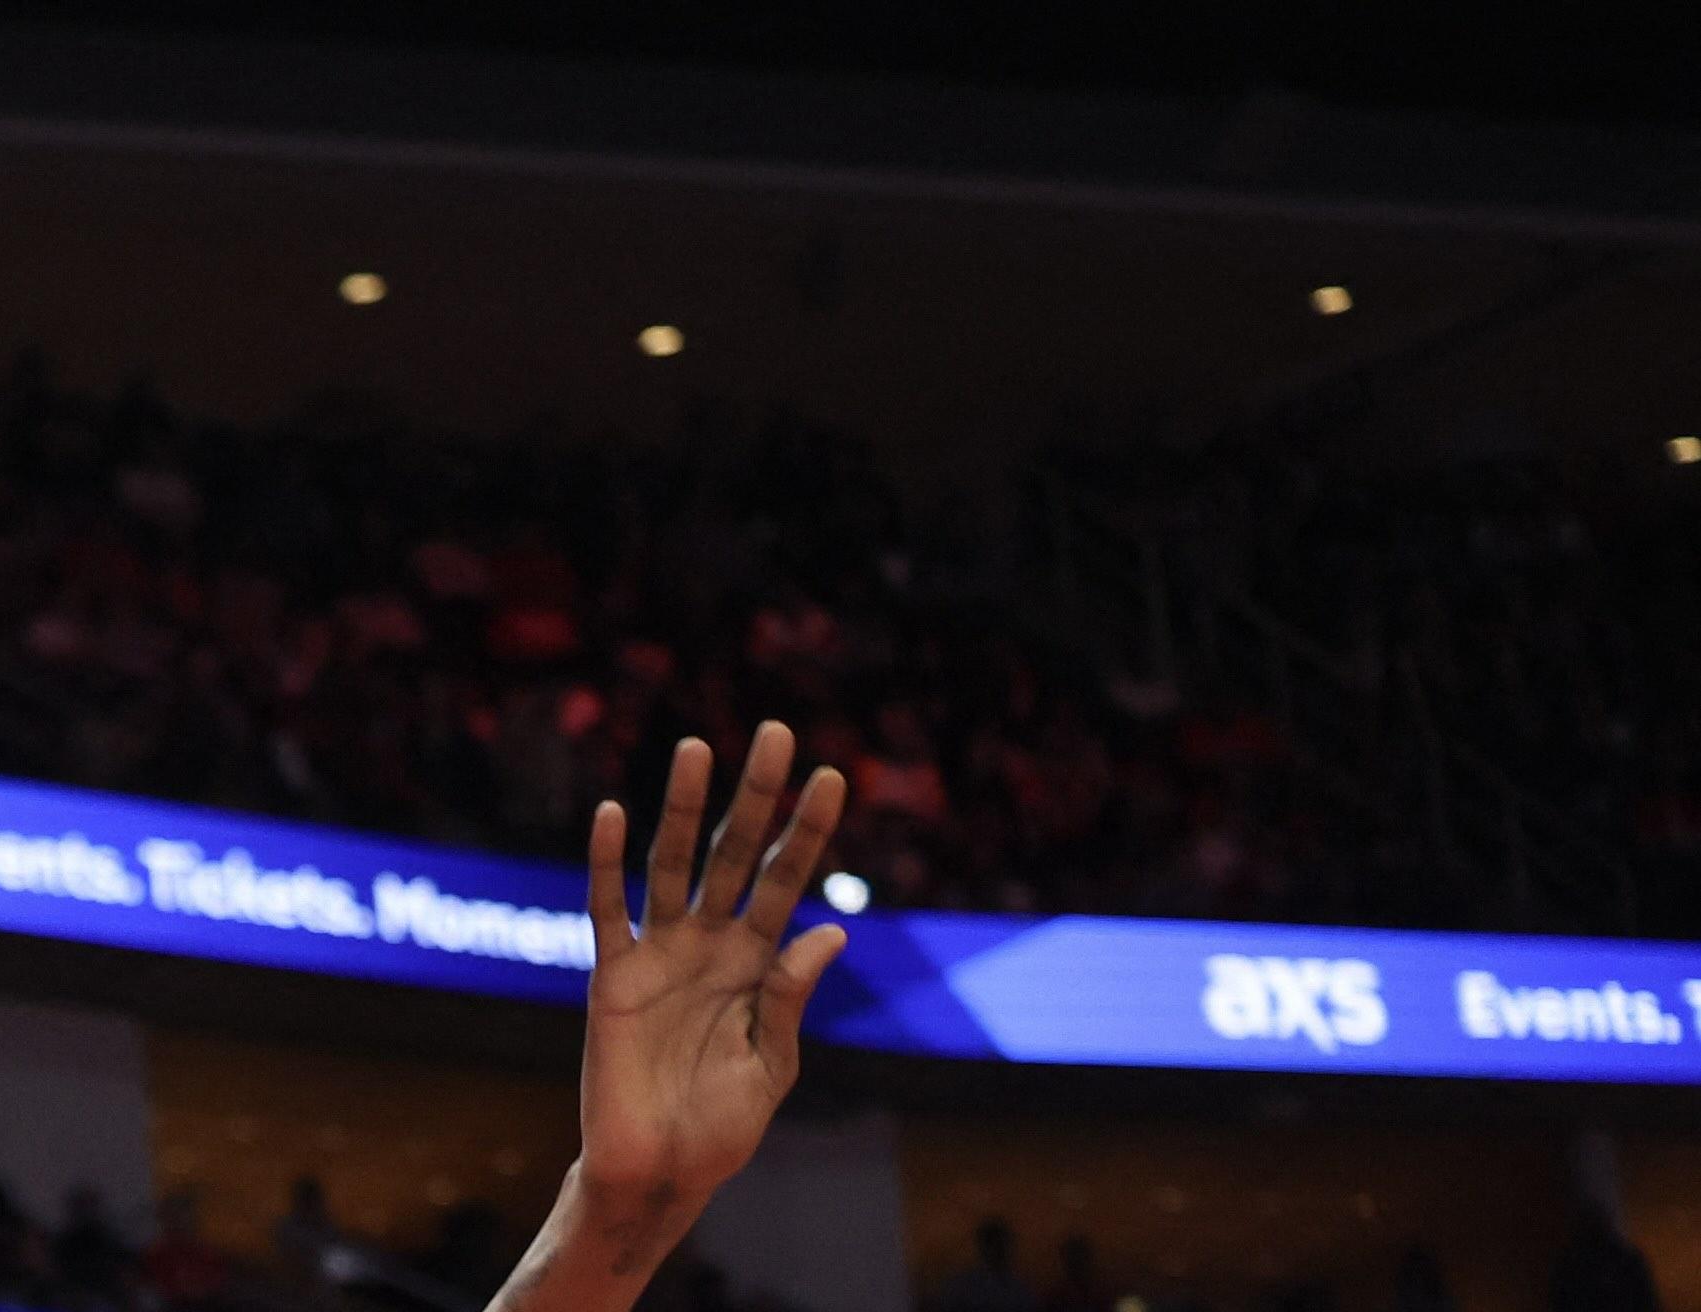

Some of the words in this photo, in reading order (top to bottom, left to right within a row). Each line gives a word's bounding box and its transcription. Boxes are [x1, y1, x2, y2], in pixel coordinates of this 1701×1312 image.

[137, 836, 376, 938] Tickets.
[373, 872, 596, 970] Momen
[1202, 953, 1387, 1053] axs
[1457, 969, 1683, 1044] Events.
